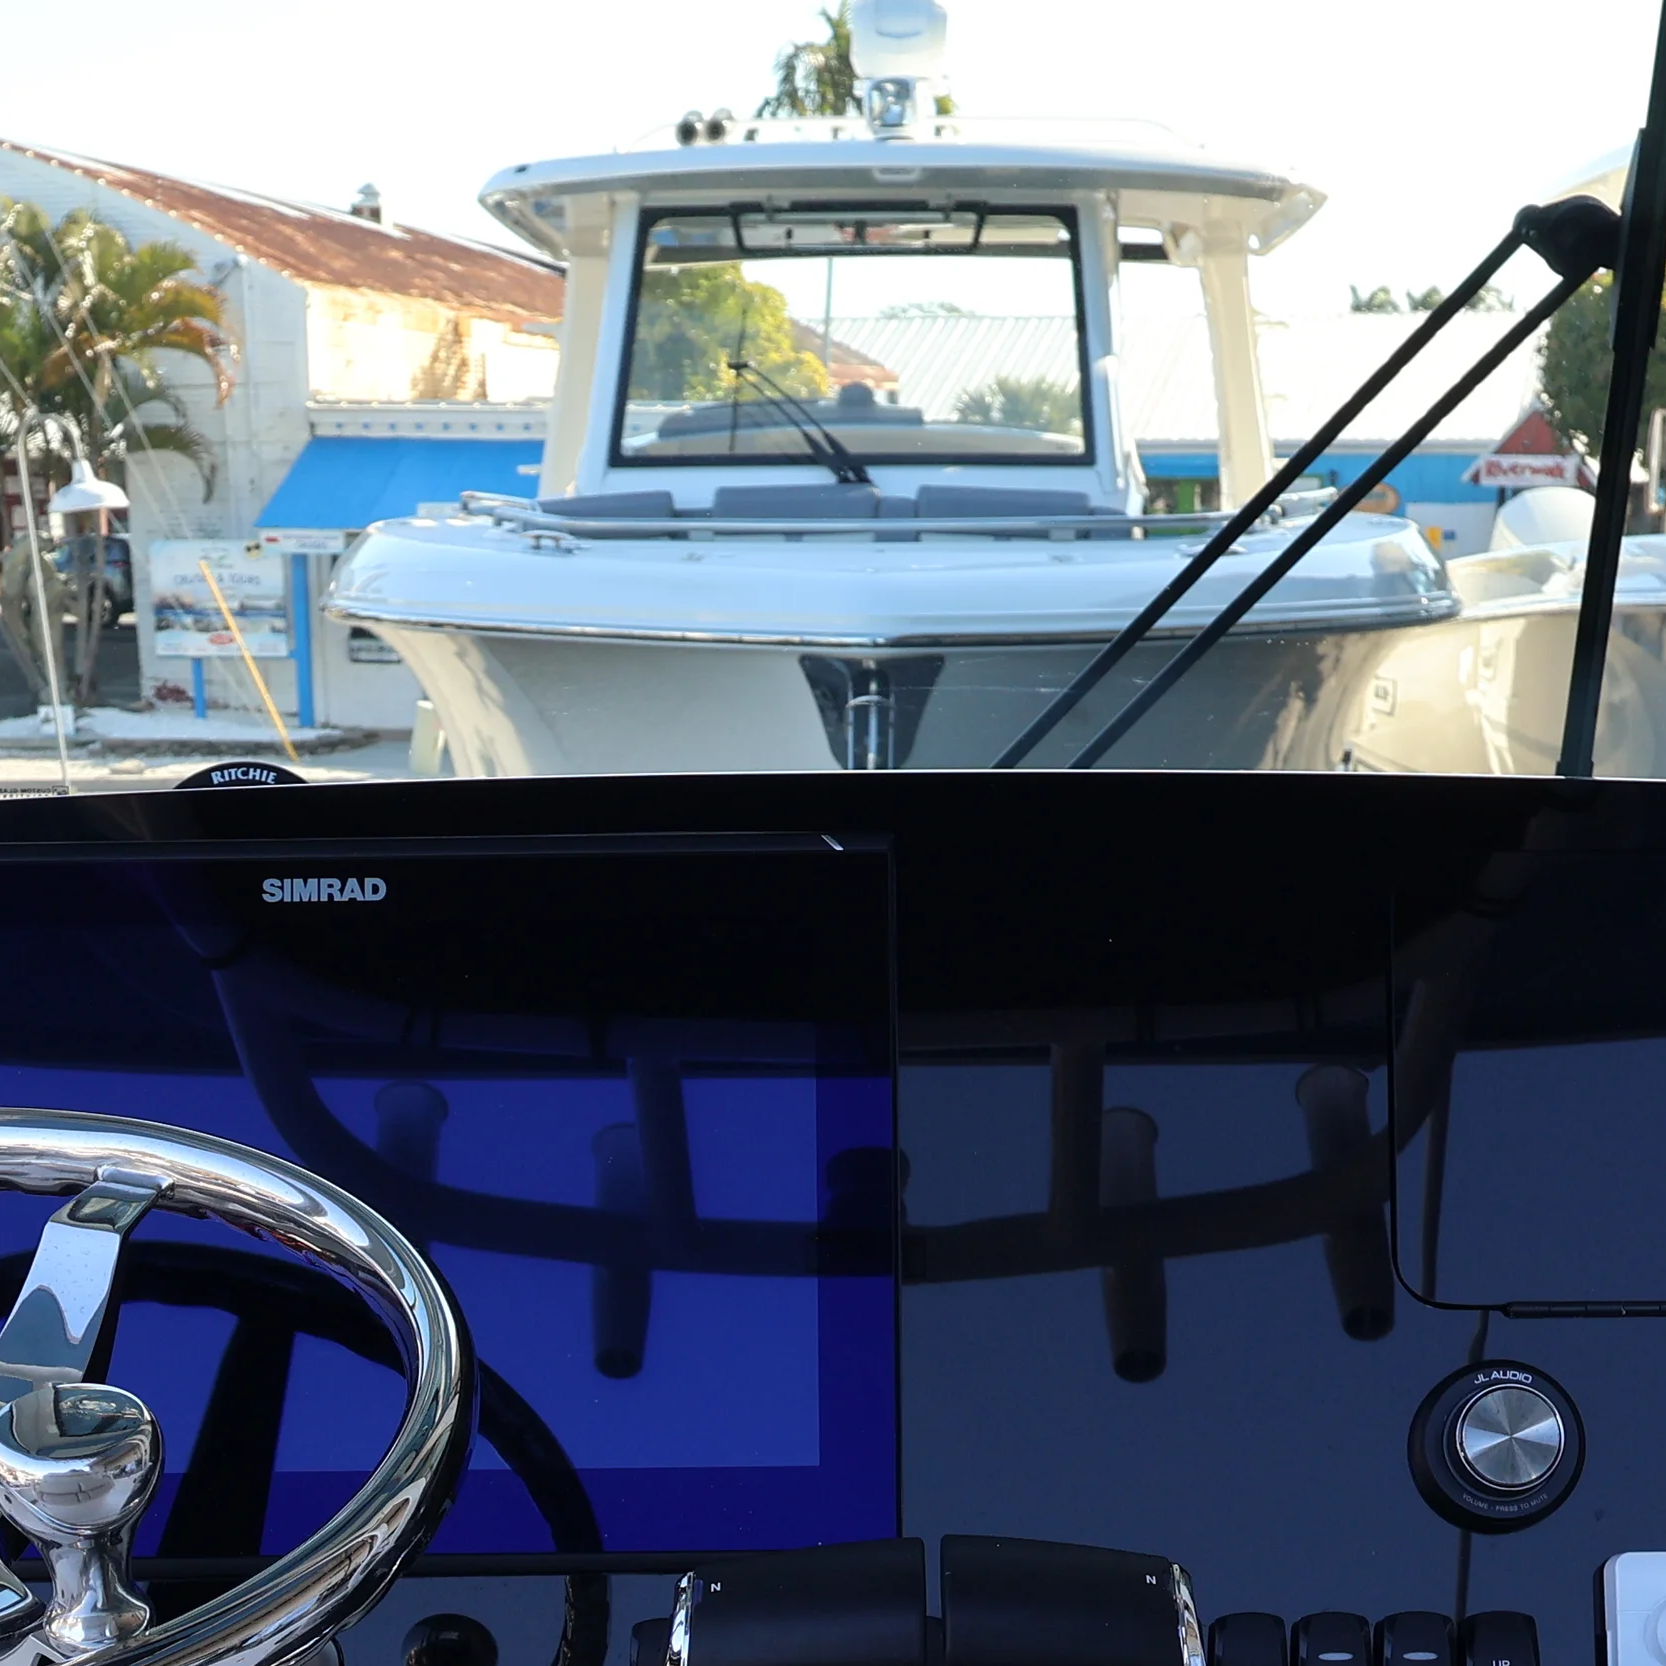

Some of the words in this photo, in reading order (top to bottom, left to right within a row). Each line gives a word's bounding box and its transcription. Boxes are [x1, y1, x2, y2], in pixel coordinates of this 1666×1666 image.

[210, 767, 278, 785] RITCHIE
[261, 877, 387, 903] SIMRAD
[1473, 1373, 1489, 1385] JL
[1491, 1370, 1533, 1384] AUDIO
[1462, 1492, 1489, 1510] VOLUME
[1495, 1504, 1518, 1512] PRESS
[1520, 1502, 1530, 1510] TO
[1530, 1492, 1549, 1508] MUTE
[710, 1582, 722, 1593] N
[1145, 1574, 1157, 1585] N
